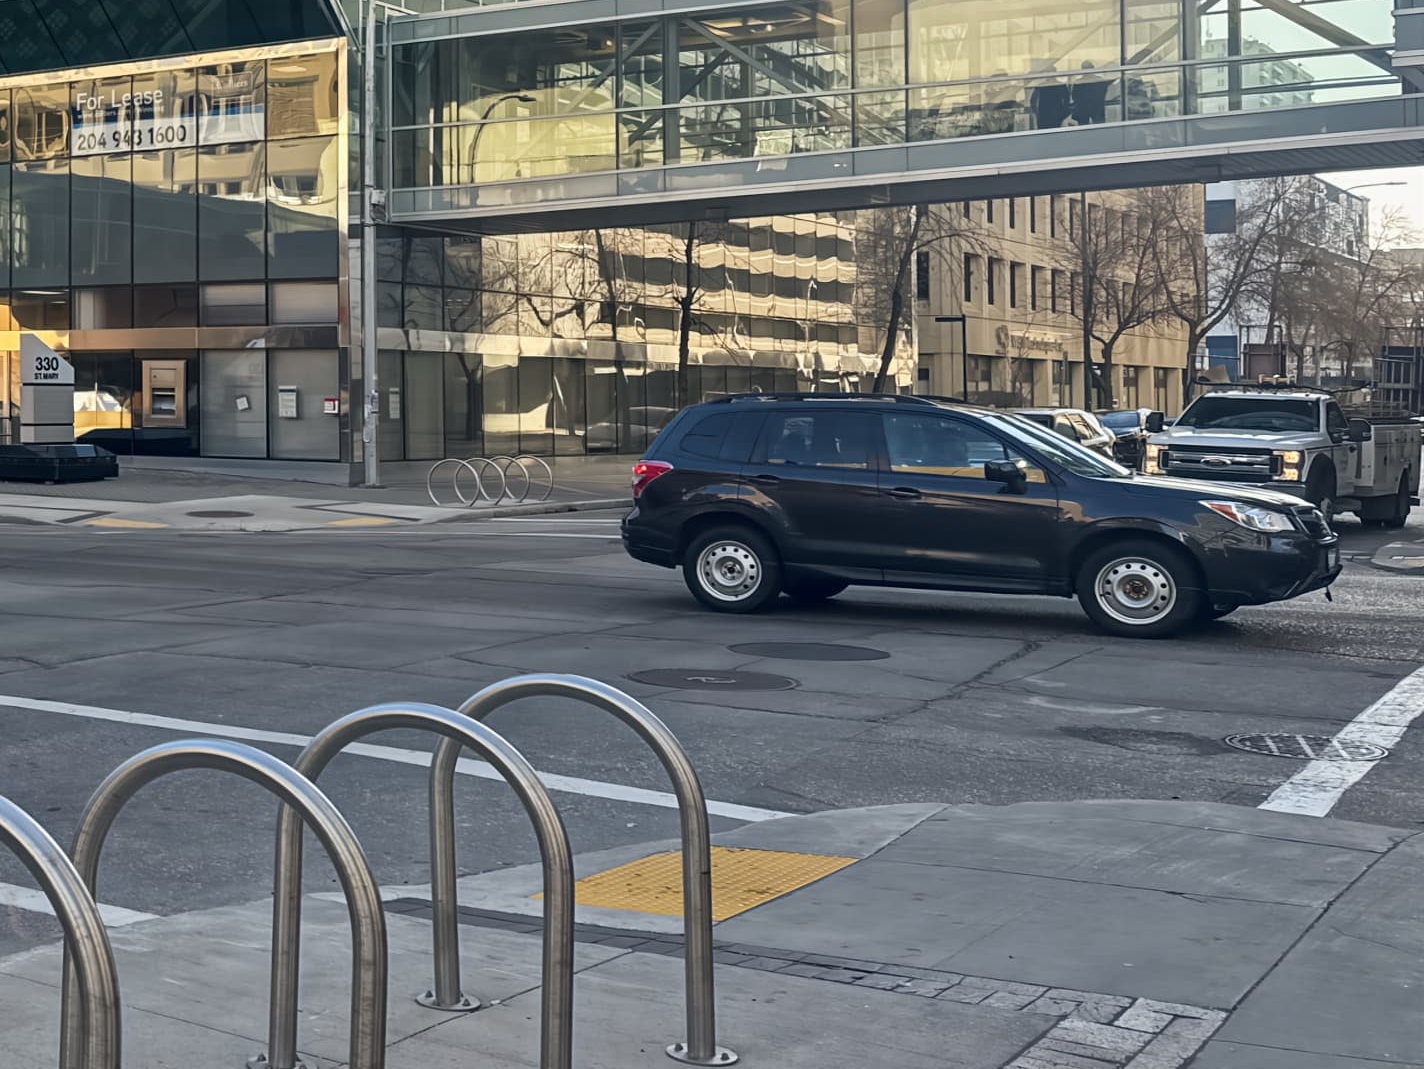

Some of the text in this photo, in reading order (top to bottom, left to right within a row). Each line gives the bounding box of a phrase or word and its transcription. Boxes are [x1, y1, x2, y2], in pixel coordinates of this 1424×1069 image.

[76, 89, 163, 111] For Lease
[78, 125, 186, 150] 204 943 1600
[36, 357, 59, 371] 330
